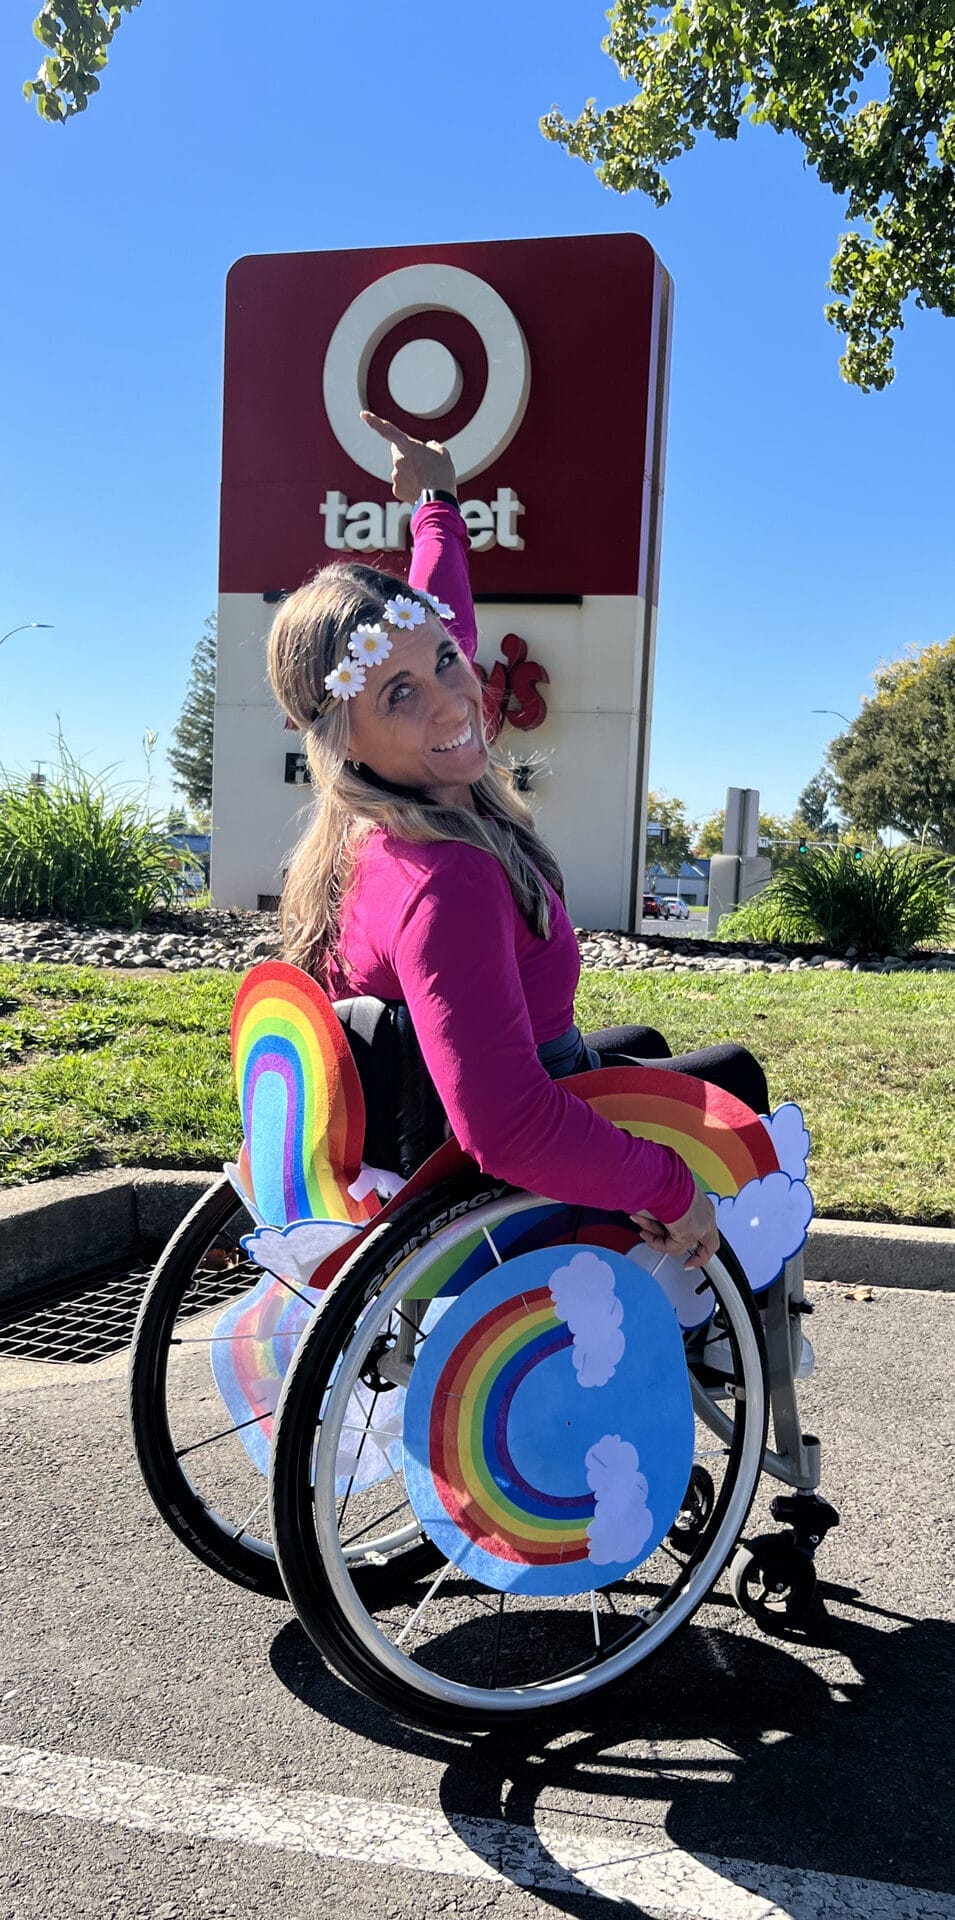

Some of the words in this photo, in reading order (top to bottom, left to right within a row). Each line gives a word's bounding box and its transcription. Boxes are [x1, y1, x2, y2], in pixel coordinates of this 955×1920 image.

[319, 488, 525, 553] taret
[363, 1184, 509, 1304] SPINERGY
[168, 1503, 259, 1586] SCHWALBE
